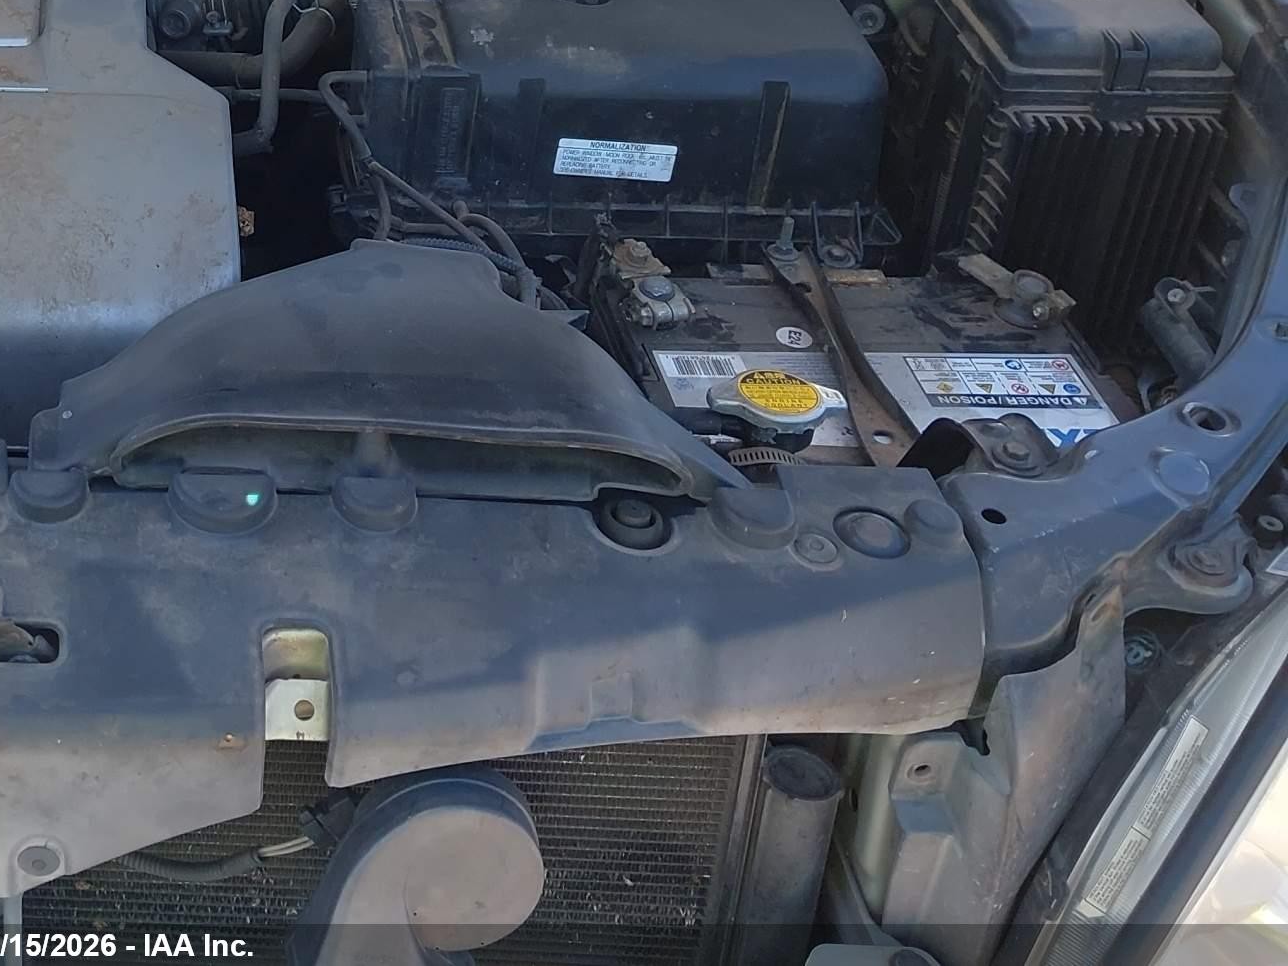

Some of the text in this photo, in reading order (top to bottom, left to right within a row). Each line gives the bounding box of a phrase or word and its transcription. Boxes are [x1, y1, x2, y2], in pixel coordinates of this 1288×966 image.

[590, 141, 647, 151] NORMALIZATION
[937, 394, 997, 405] POISON
[1006, 395, 1073, 406] DANGER
